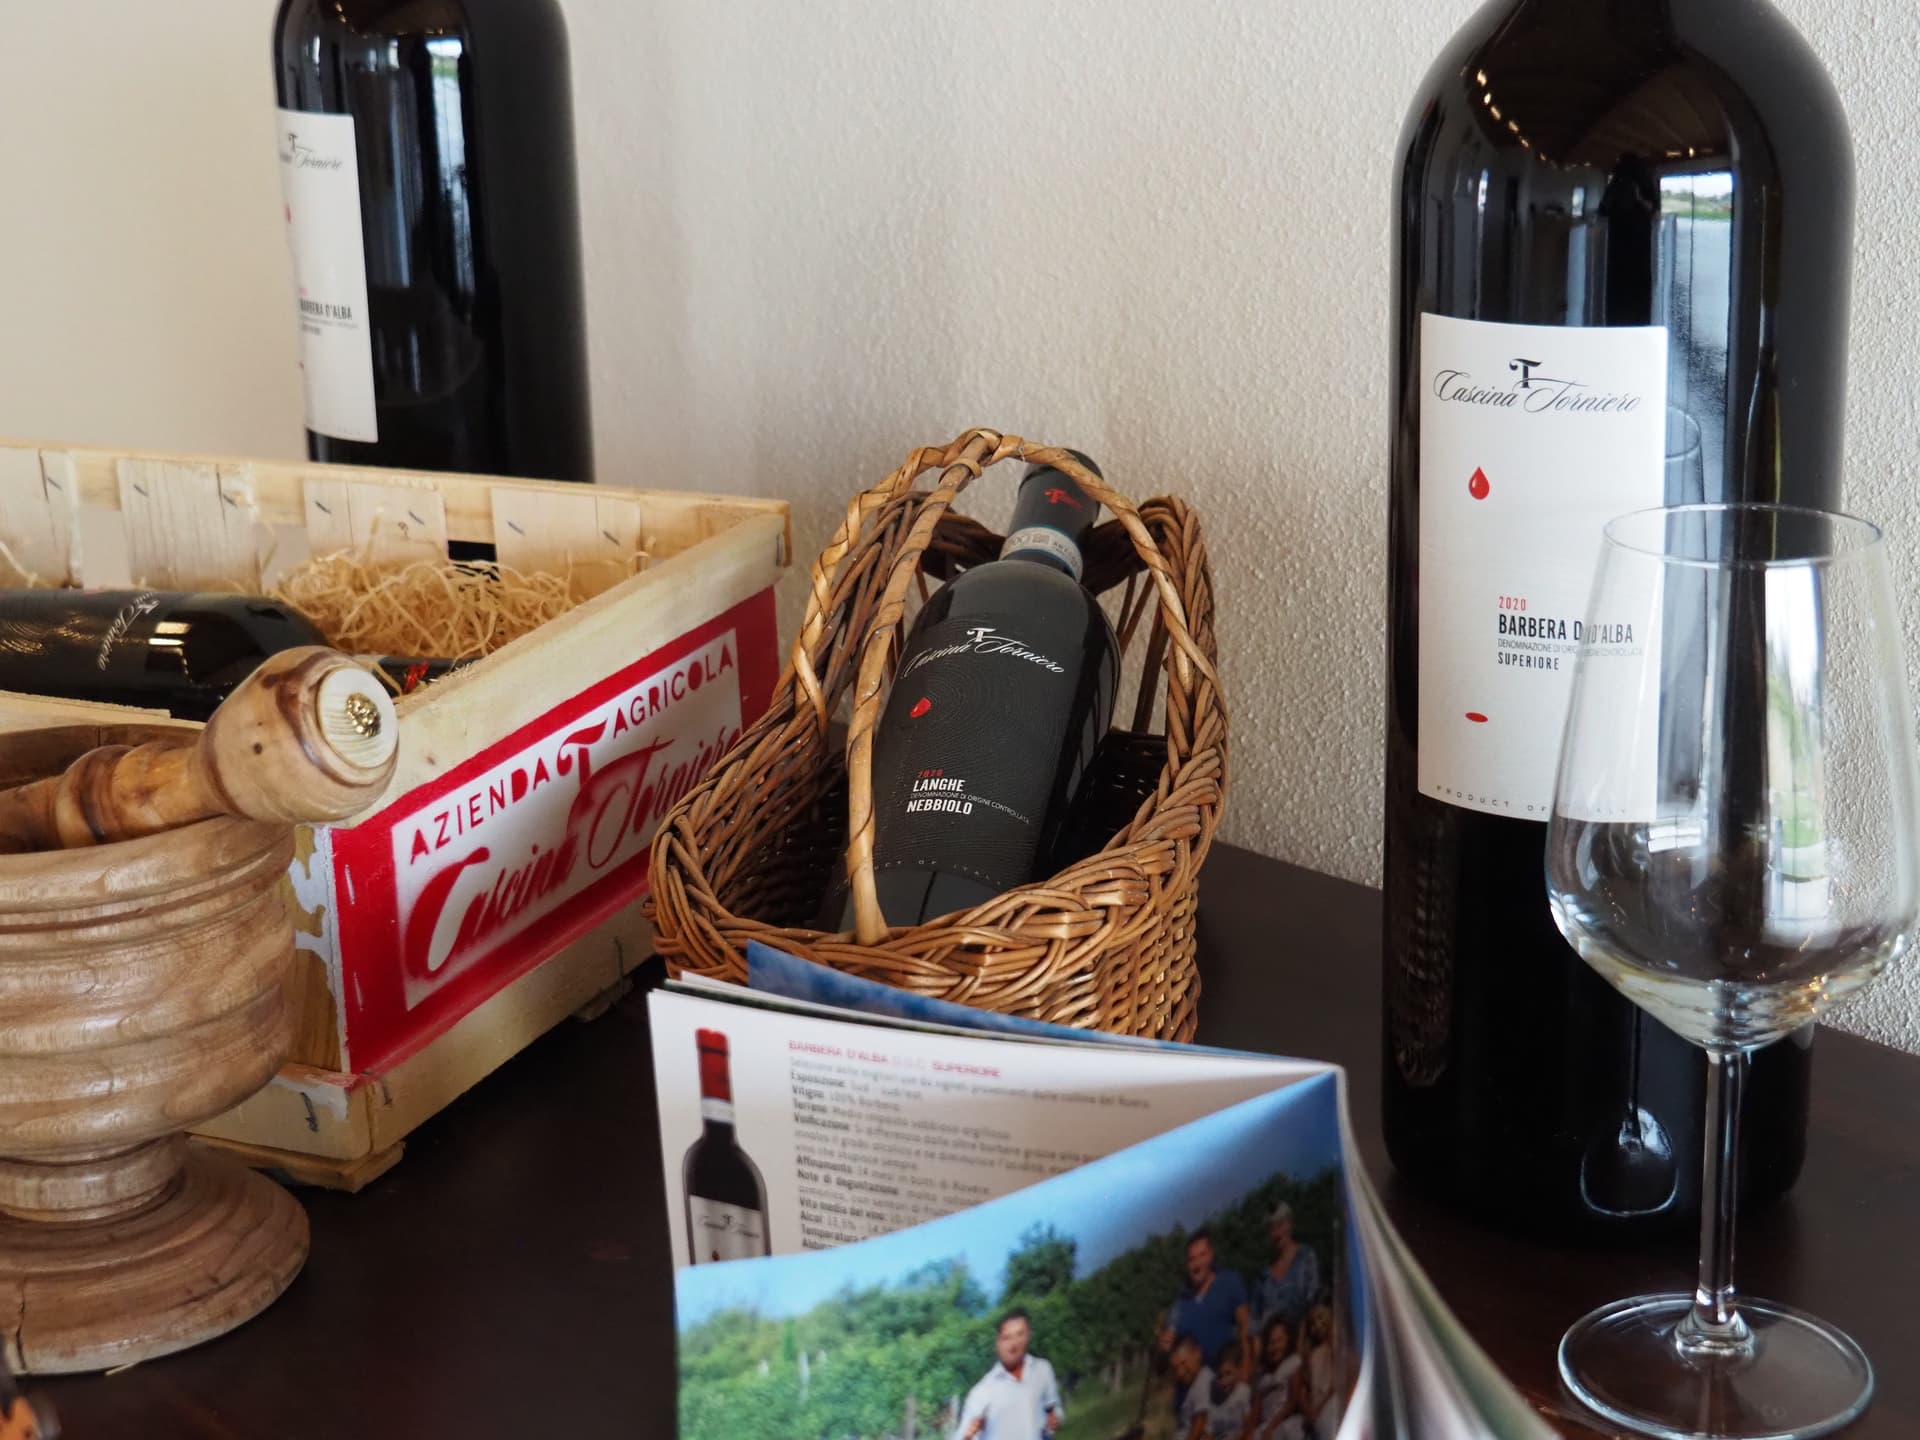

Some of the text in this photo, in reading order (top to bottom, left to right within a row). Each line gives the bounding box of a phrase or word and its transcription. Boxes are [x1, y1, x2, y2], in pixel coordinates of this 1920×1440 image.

[1433, 369, 1642, 413] Cascina Torniero
[1498, 595, 1528, 611] 2020
[1498, 613, 1567, 640] BARBERA
[966, 635, 1065, 674] Torniero
[1497, 638, 1553, 653] DENOMINAZIONE
[1497, 651, 1560, 671] SUPERIORE
[409, 643, 735, 866] AZIENDA AGRICOLA
[910, 791, 960, 799] DENOMINAZIONE
[912, 778, 966, 793] LANGHE
[1436, 785, 1509, 807] PRODUCT
[906, 799, 973, 815] NEBBIOLO
